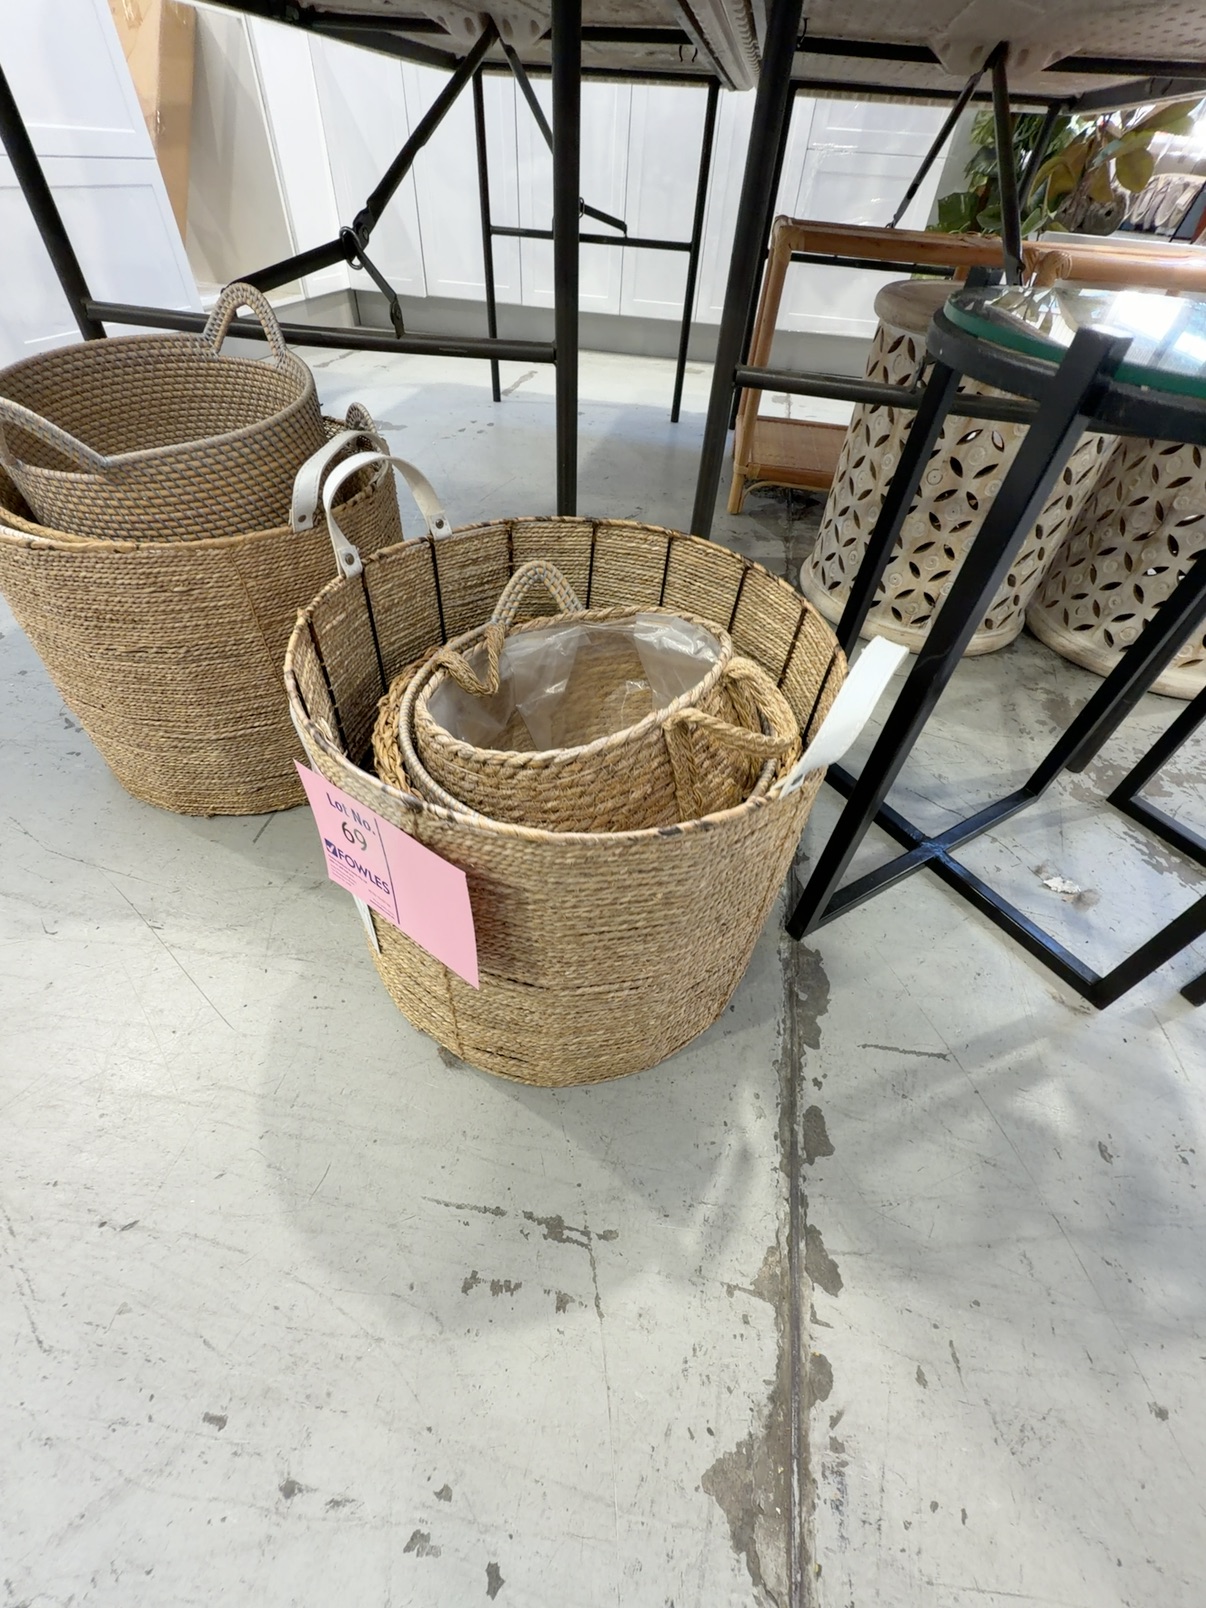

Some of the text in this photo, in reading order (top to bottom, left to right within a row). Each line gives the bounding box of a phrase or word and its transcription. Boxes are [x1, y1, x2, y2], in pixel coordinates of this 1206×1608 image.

[326, 792, 376, 836] Lot No.
[341, 821, 367, 851] 69
[337, 848, 391, 895] FOWLES
